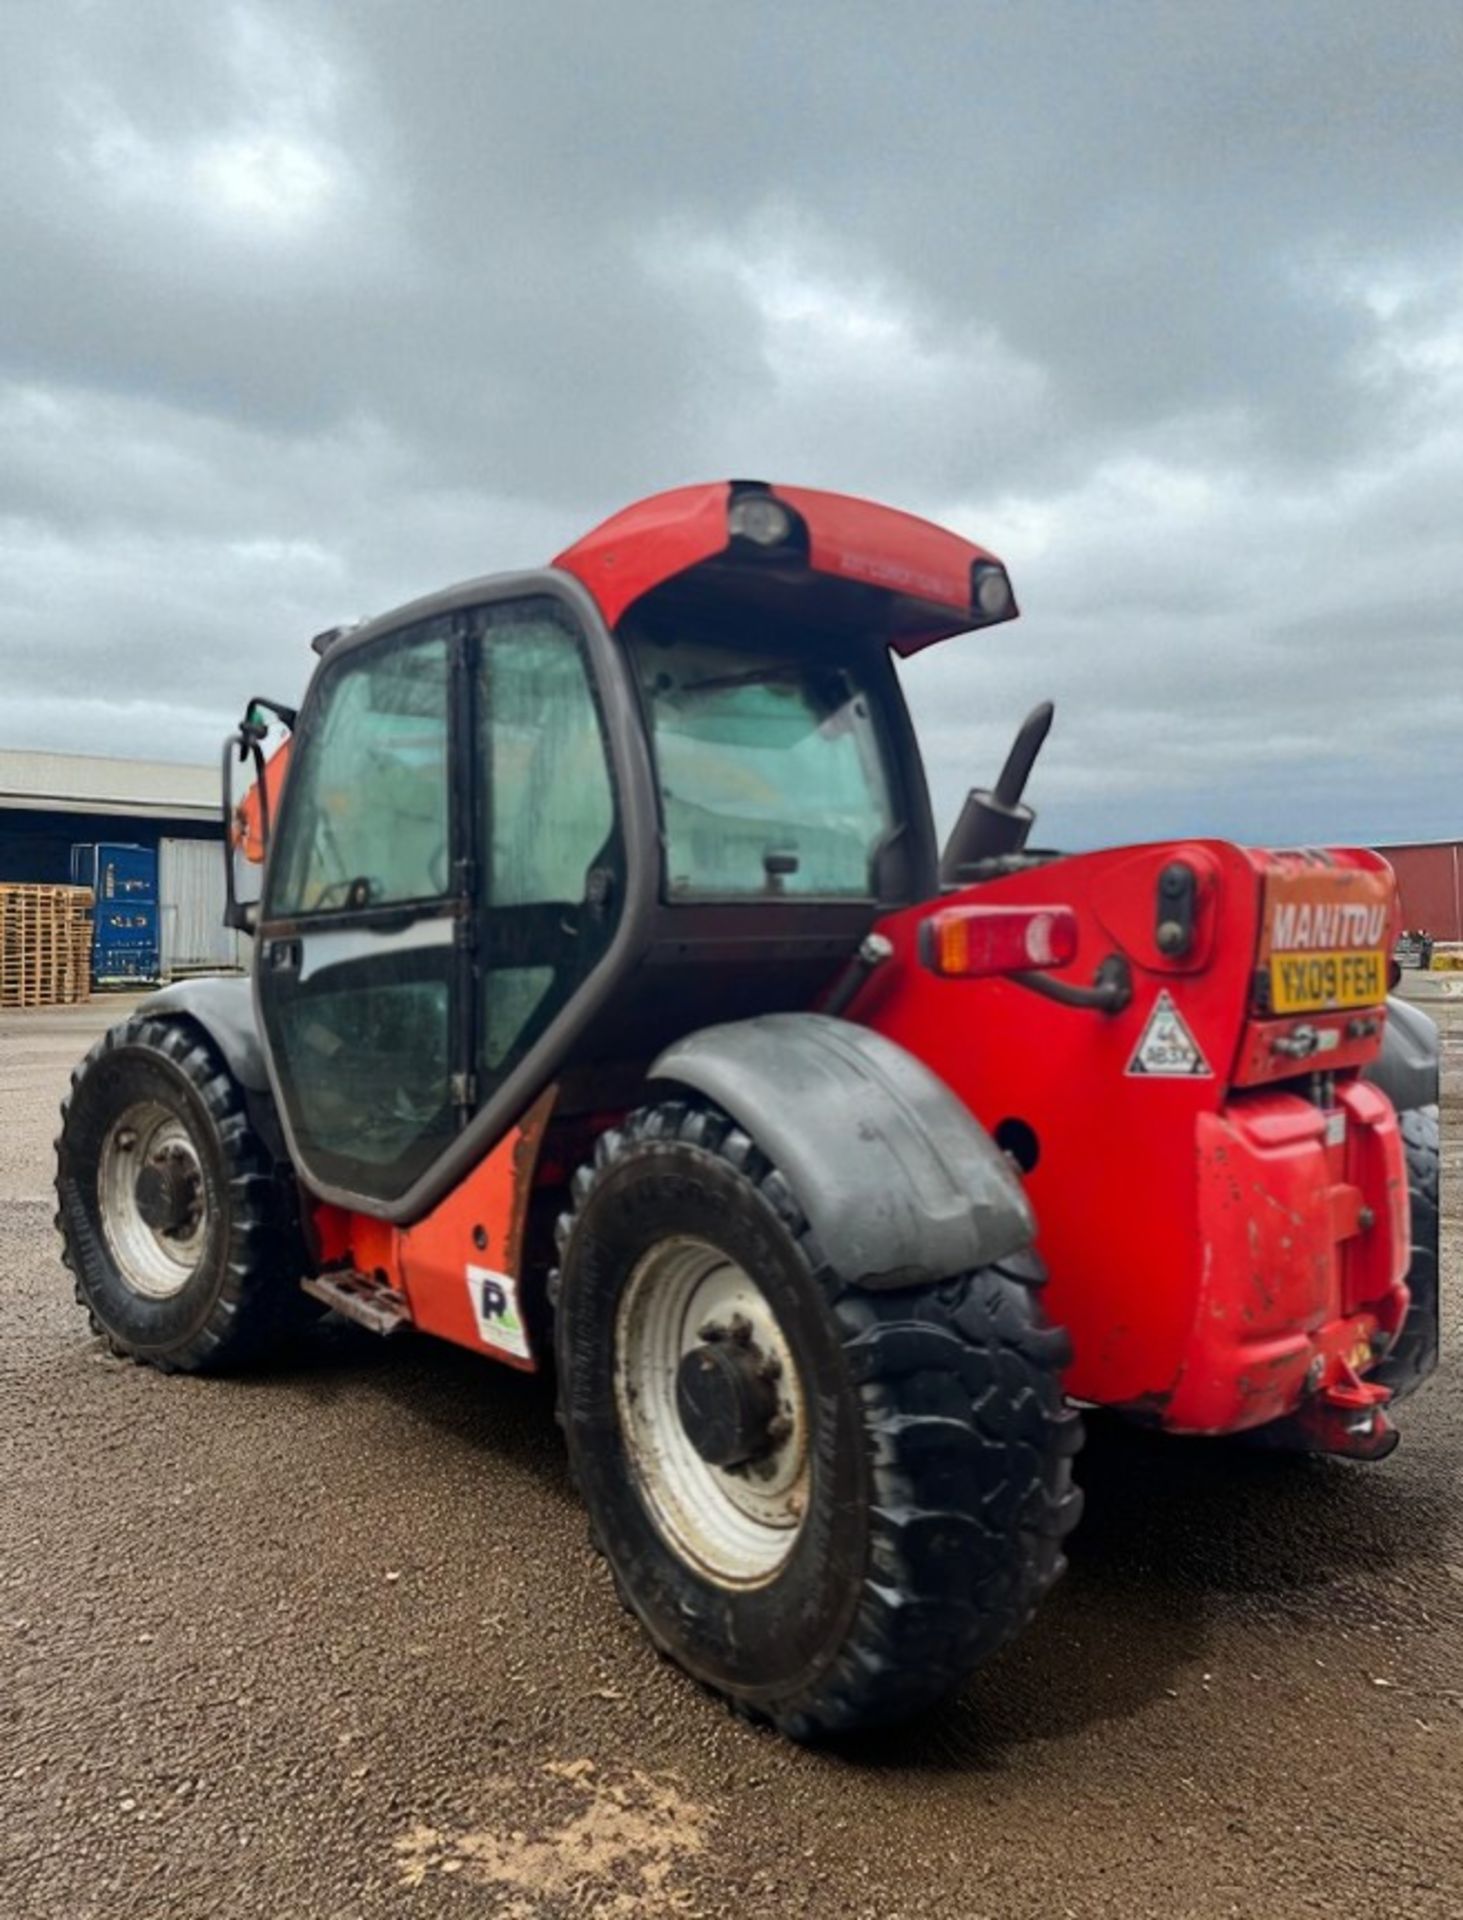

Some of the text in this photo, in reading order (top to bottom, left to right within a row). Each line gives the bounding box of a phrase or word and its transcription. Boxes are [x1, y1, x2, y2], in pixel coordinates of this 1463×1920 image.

[1271, 903, 1387, 949] MANITOU
[1280, 956, 1379, 1003] YX09 FEH
